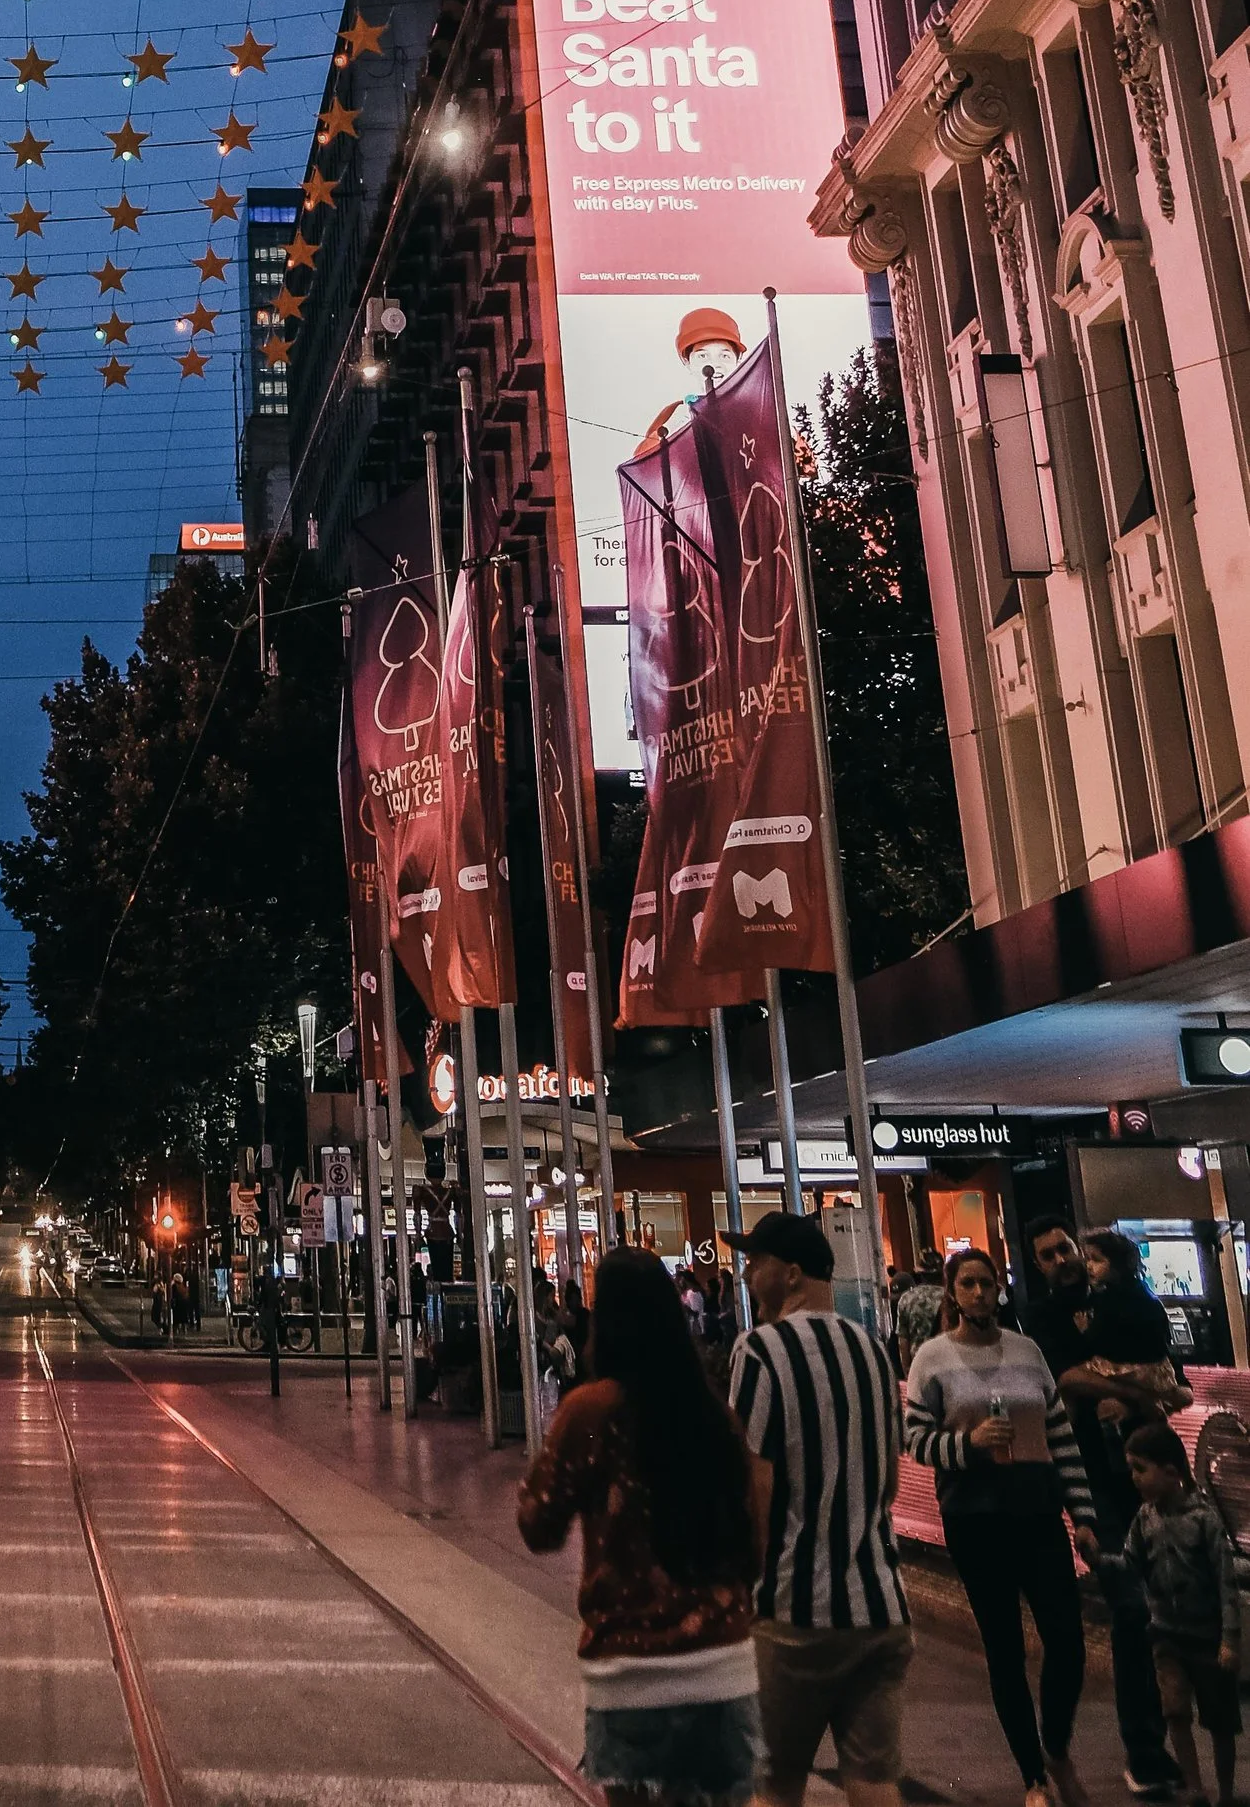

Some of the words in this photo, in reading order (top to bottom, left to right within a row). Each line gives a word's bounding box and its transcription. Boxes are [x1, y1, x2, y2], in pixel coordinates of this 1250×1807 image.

[561, 33, 758, 88] Santa
[566, 99, 640, 153] to
[651, 96, 701, 153] it
[572, 176, 610, 191] Free
[613, 176, 680, 193] Express
[682, 176, 734, 191] Metro
[737, 175, 807, 193] Delivery
[573, 195, 609, 211] with
[611, 195, 654, 213] eBay
[657, 195, 699, 211] Plus.
[627, 272, 640, 280] and
[679, 273, 701, 282] apply
[594, 554, 616, 567] for
[902, 1123, 977, 1148] sunglass
[980, 1122, 1011, 1143] hut
[330, 1155, 347, 1163] END
[303, 1208, 323, 1216] ONLY
